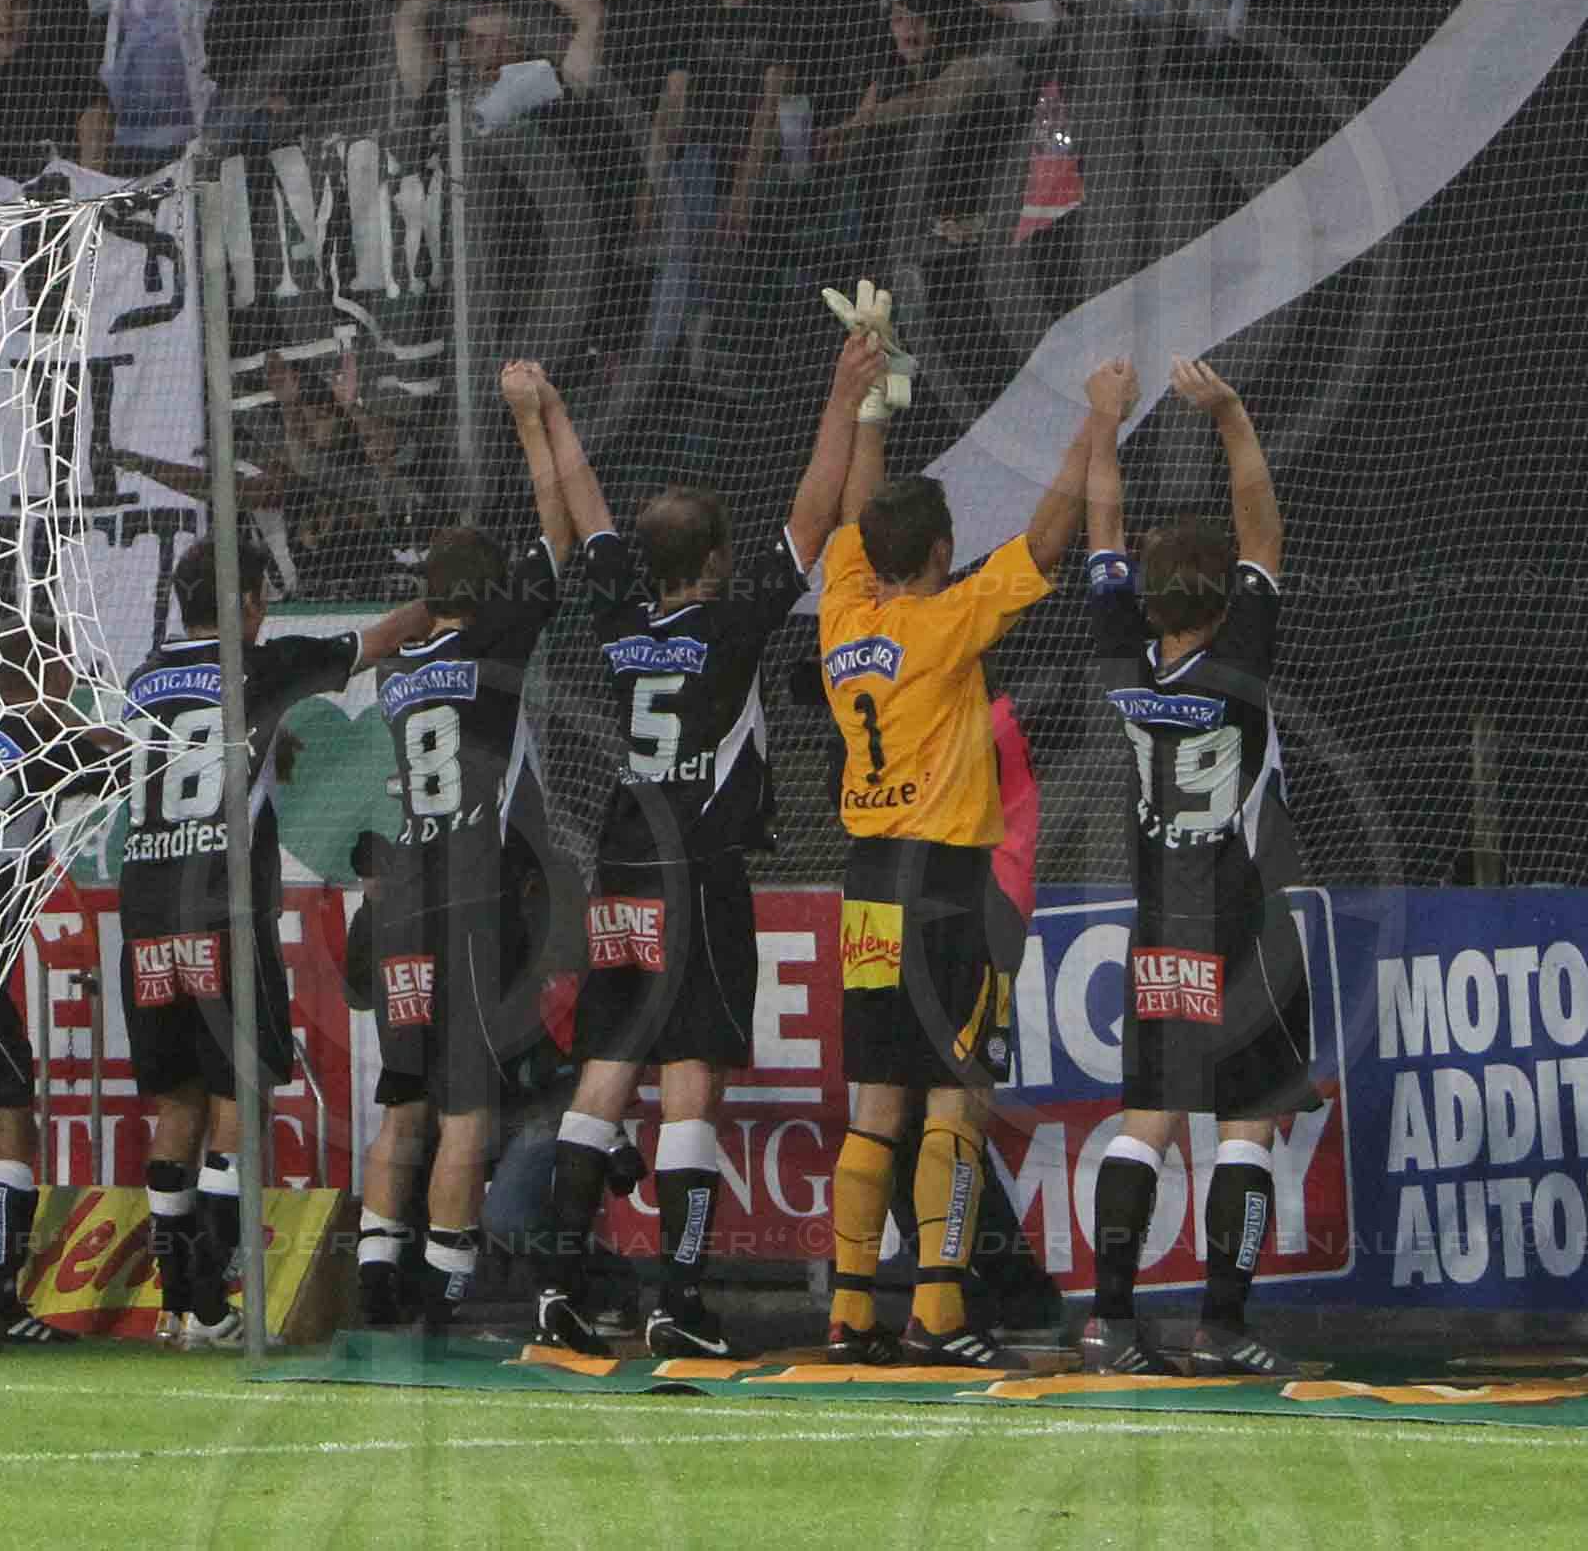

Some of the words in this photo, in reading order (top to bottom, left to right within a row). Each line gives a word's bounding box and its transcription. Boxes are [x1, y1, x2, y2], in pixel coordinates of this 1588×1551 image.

[125, 706, 226, 827] 18
[405, 705, 462, 816] 8
[628, 675, 682, 783] 5
[1125, 721, 1241, 833] 19
